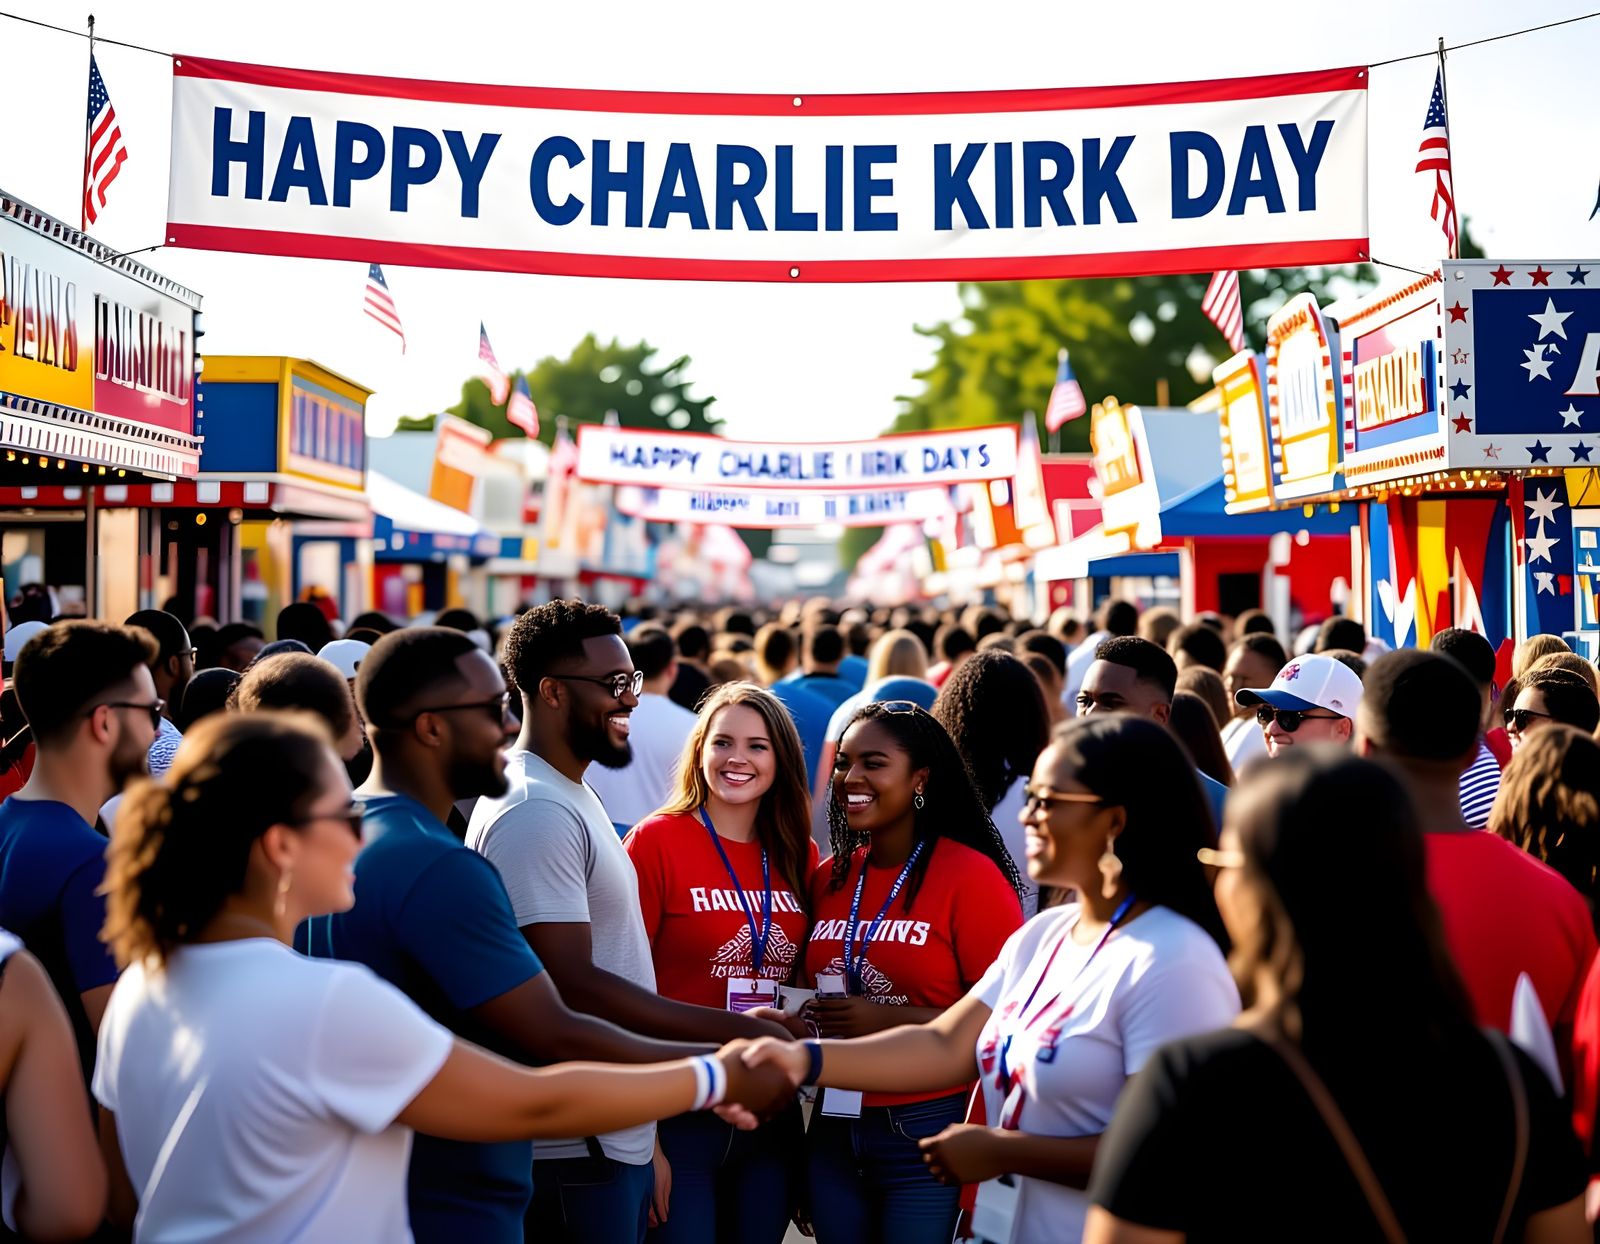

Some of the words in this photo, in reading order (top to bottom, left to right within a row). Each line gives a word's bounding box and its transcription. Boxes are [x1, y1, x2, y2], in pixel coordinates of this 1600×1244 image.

[211, 106, 502, 218] HAPPY
[529, 135, 898, 231] CHARLIE
[933, 135, 1138, 230] KIRK
[1169, 120, 1335, 219] DAY
[609, 443, 701, 473] HAPPY
[921, 443, 991, 474] DAYS
